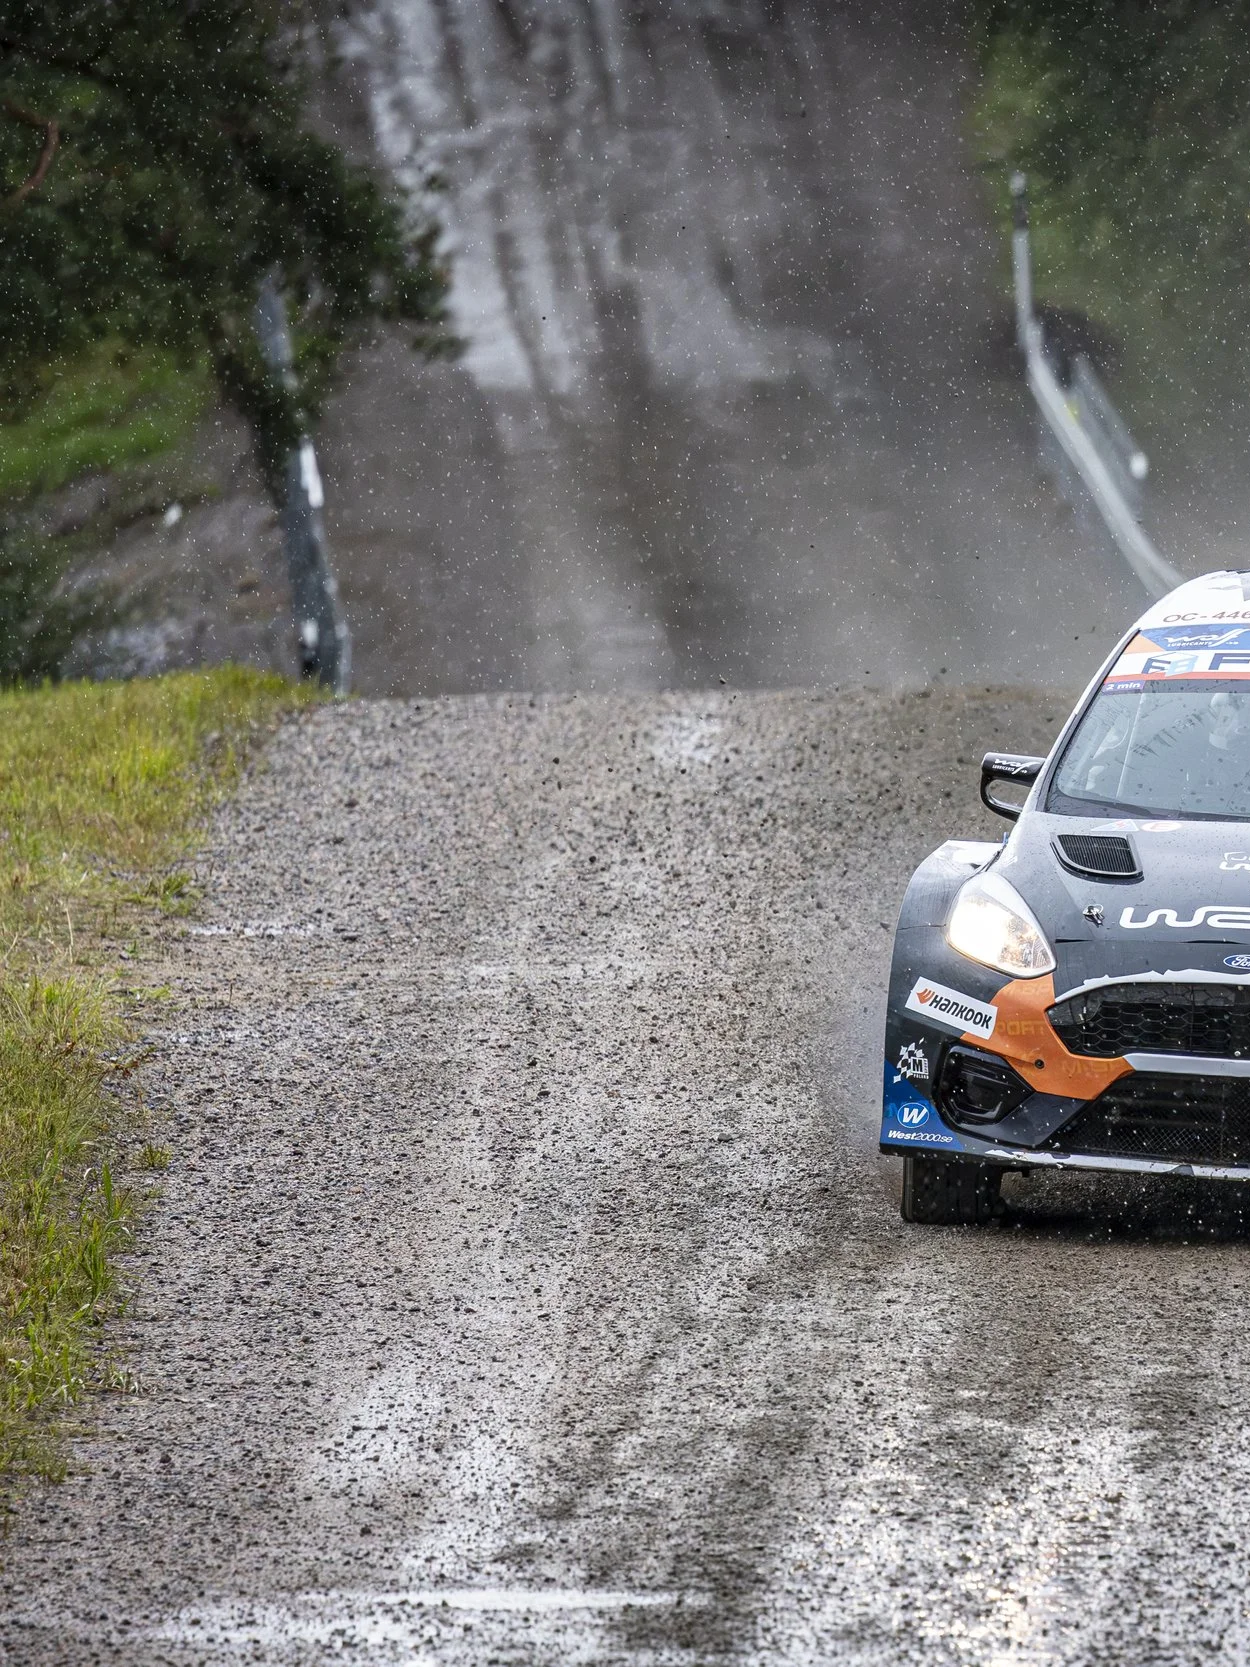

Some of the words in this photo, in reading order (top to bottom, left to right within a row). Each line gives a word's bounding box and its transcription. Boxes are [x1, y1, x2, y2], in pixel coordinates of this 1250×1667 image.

[1117, 682, 1140, 690] min
[902, 1109, 926, 1124] W
[887, 1129, 953, 1144] West2000.se
